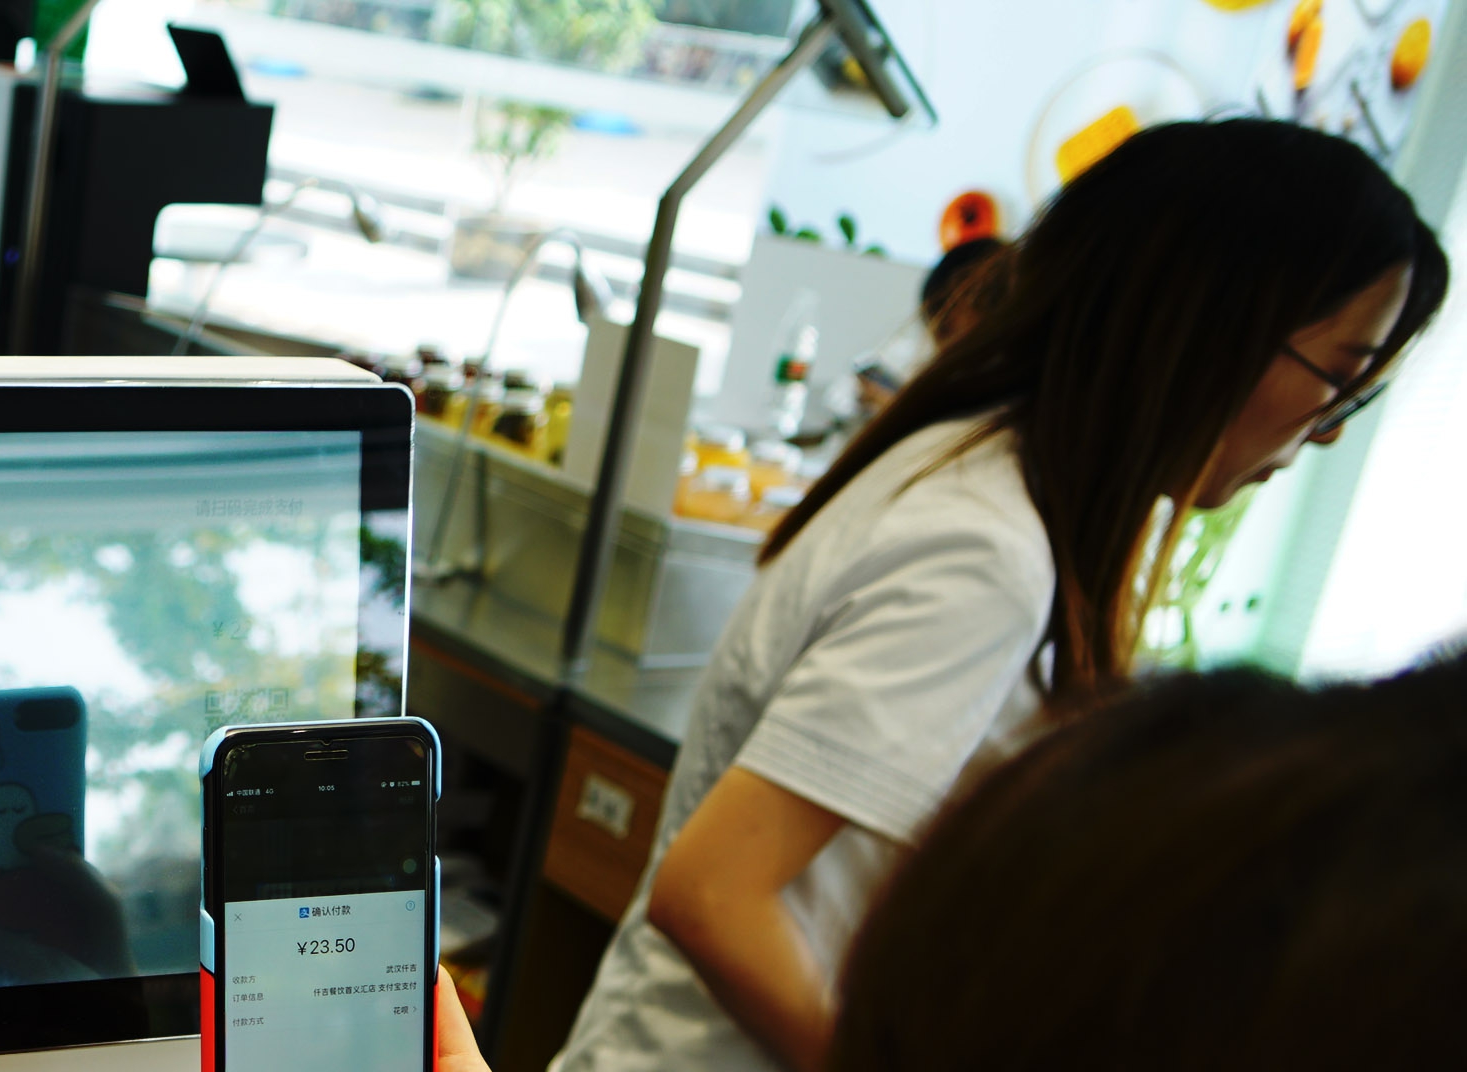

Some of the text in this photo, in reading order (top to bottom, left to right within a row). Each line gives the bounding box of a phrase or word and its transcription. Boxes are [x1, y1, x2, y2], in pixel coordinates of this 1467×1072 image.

[312, 905, 351, 917] 确认付款
[297, 938, 355, 955] ¥23.50
[232, 975, 256, 985] 收款方
[378, 981, 417, 993] 支付宝支付
[232, 992, 264, 1003] 订单信息
[232, 1017, 264, 1027] 付款方式
